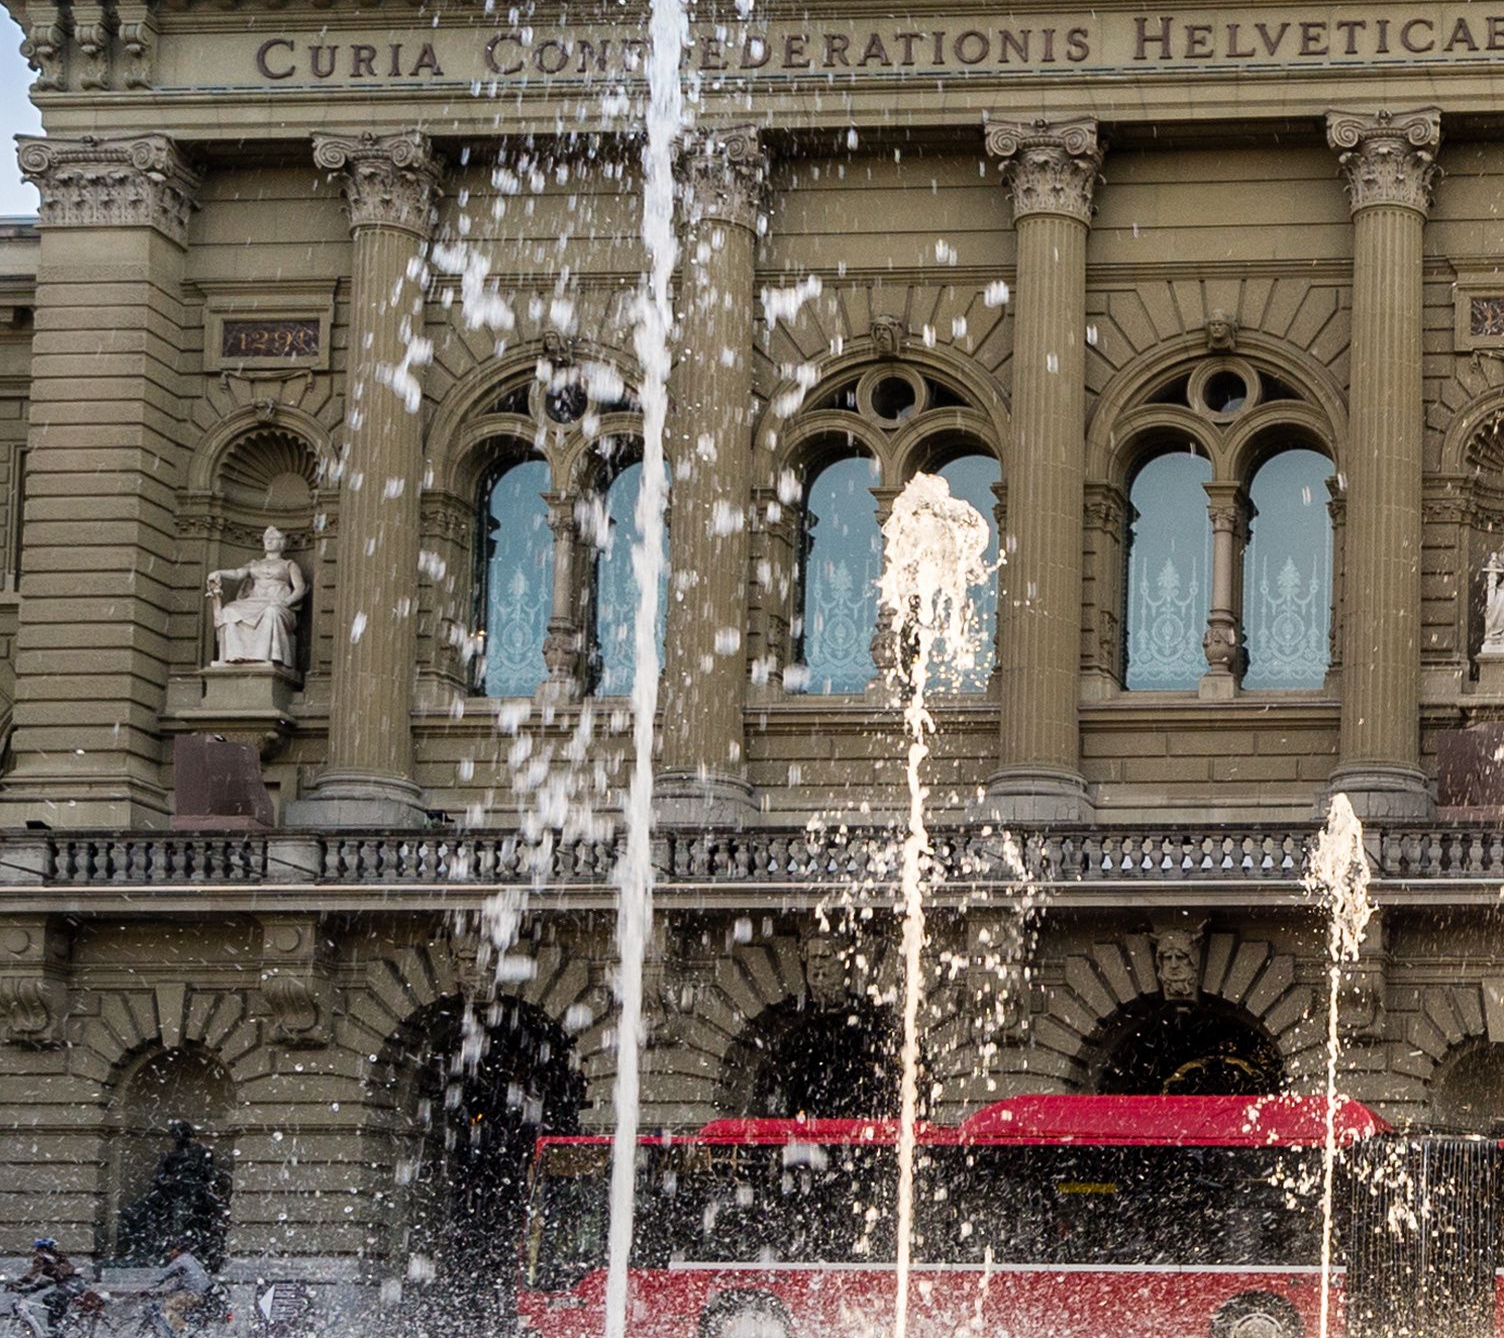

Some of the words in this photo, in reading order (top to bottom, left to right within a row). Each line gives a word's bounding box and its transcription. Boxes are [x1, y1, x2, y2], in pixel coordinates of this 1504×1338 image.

[256, 38, 444, 79] CURIA
[484, 27, 1091, 75] CONFEDERATIONIS
[240, 328, 306, 351] 1291
